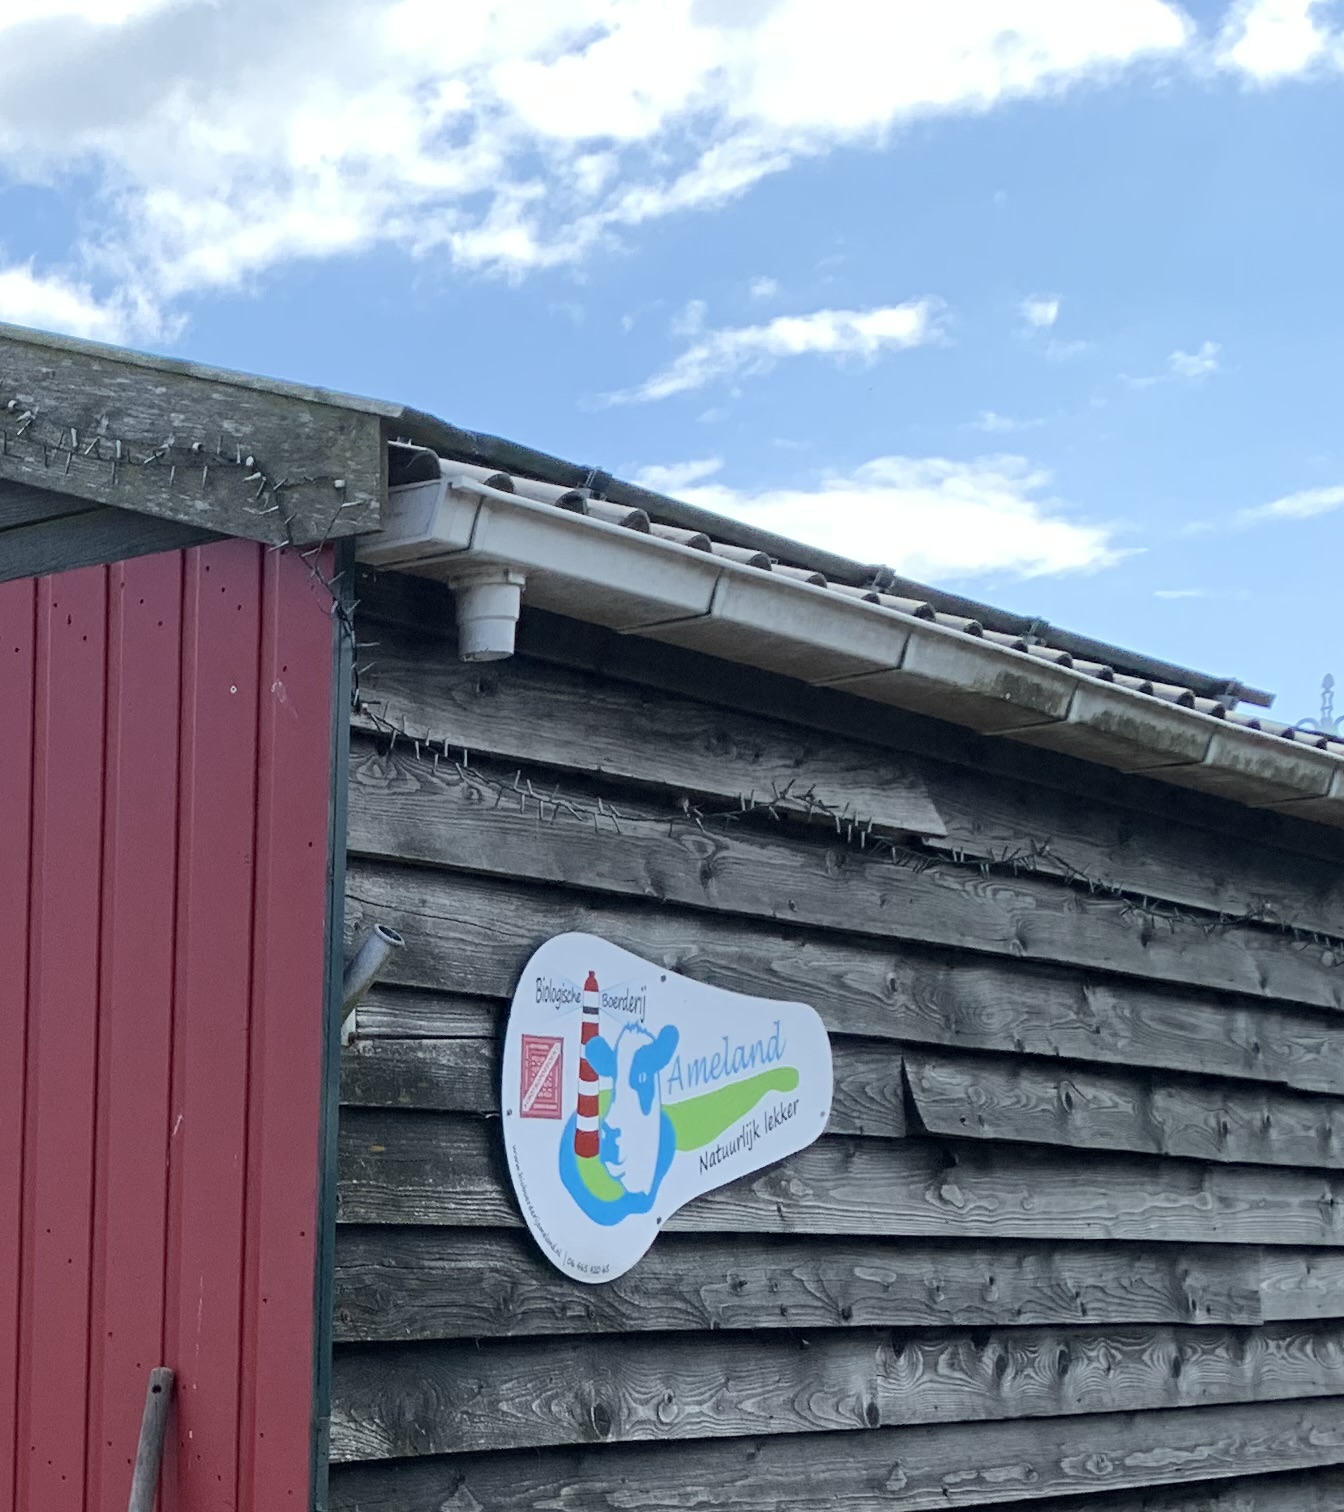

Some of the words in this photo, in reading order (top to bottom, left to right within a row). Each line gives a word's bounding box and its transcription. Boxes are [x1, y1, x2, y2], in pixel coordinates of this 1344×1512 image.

[535, 978, 582, 1009] Biologische
[602, 986, 648, 1022] Boerderij
[667, 1020, 788, 1094] Ameland
[698, 1123, 761, 1176] Natuurlijk
[764, 1098, 801, 1137] lekker
